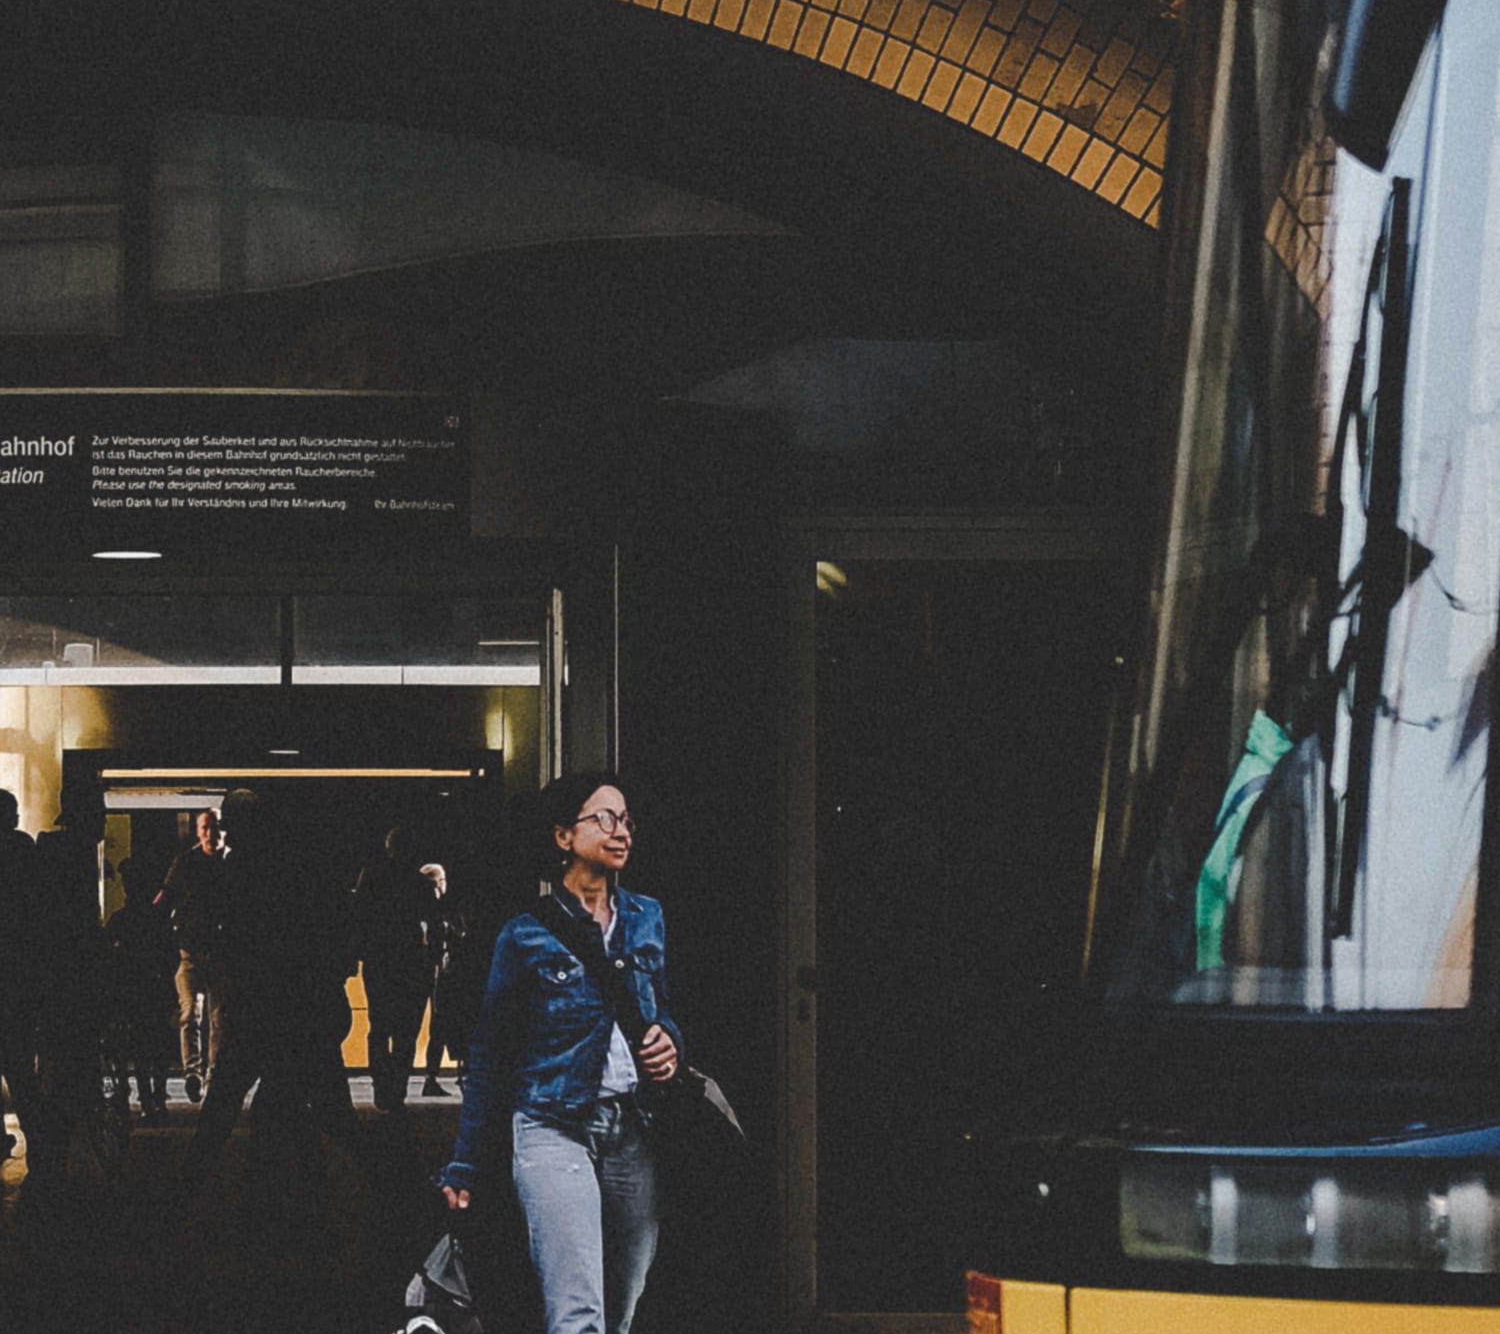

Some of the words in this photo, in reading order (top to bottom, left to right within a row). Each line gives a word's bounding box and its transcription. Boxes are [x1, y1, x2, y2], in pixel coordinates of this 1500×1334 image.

[92, 436, 109, 445] Zur
[111, 436, 181, 448] Verbesserung
[183, 436, 199, 445] der
[258, 436, 277, 446] und
[107, 450, 126, 459] das
[128, 450, 173, 460] Rauchen
[187, 450, 223, 460] diesem
[225, 450, 268, 460] Bahnhof
[118, 466, 165, 475] benutzen
[167, 466, 183, 475] Sie
[186, 466, 201, 475] die
[92, 480, 126, 490] Please
[128, 481, 146, 490] use
[167, 480, 222, 492] designated
[225, 480, 266, 492] smoking
[92, 497, 123, 507] Vielen
[125, 497, 152, 507] Dank
[249, 498, 268, 507] und
